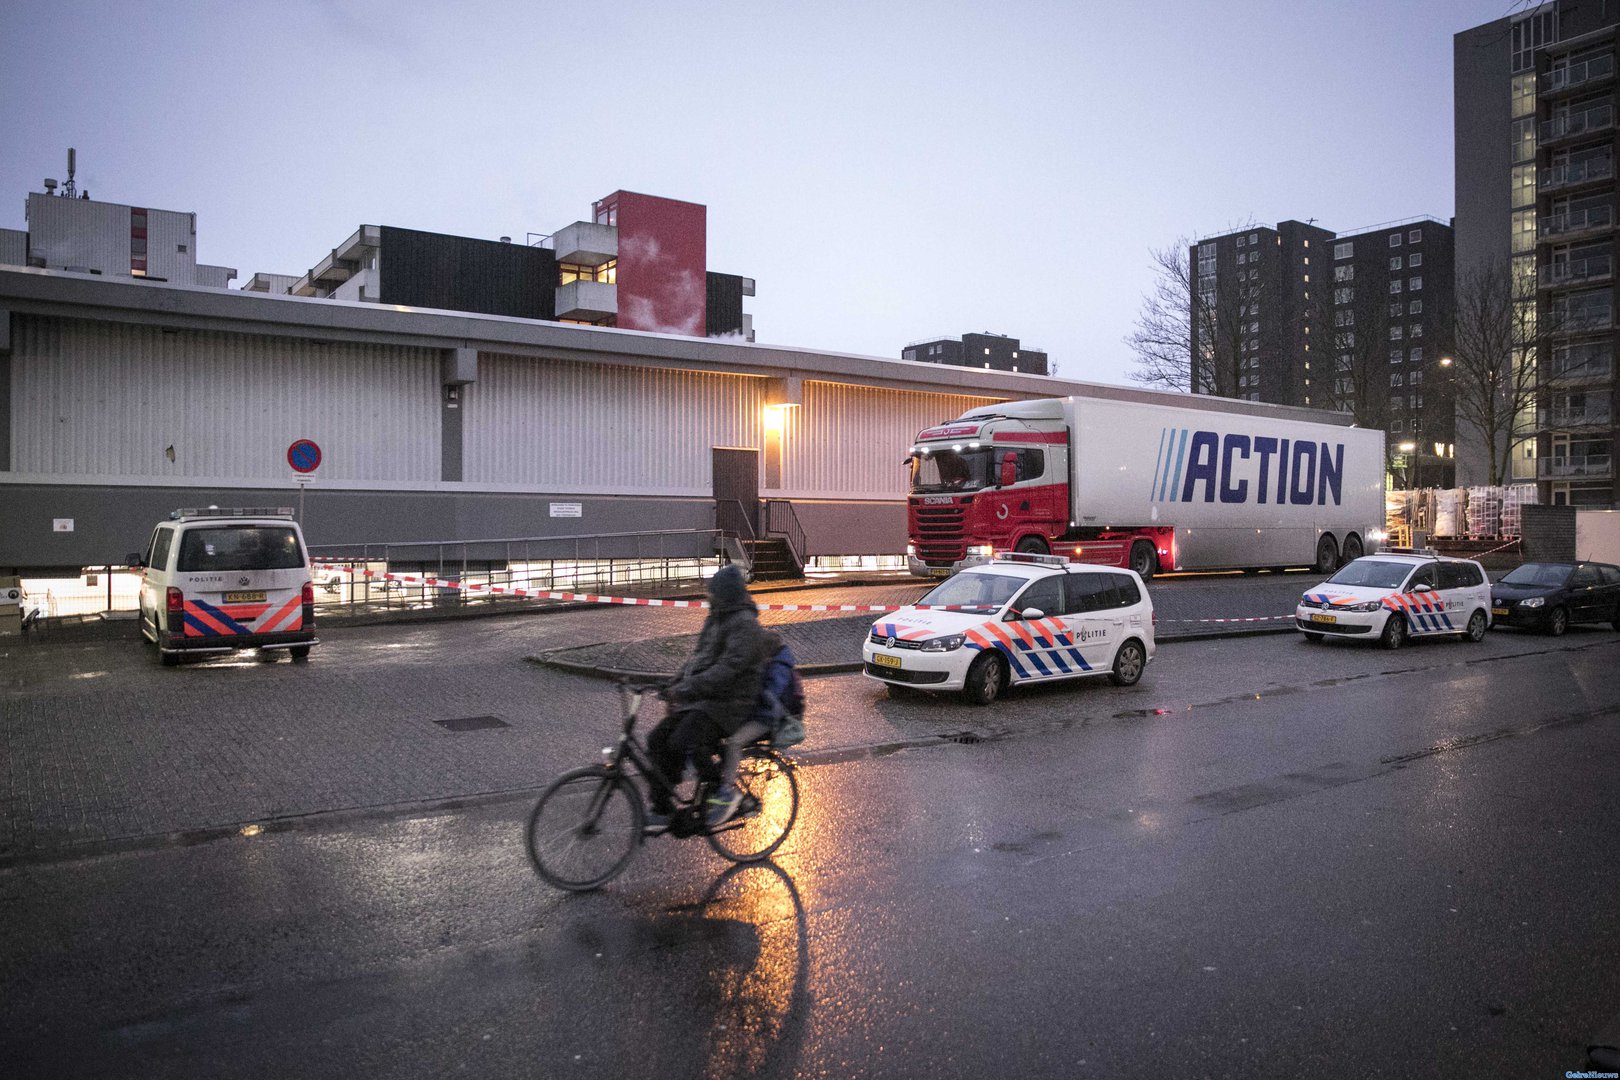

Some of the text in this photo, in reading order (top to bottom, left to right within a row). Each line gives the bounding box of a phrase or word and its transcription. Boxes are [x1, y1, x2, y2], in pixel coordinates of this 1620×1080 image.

[1181, 431, 1345, 506] ACTION
[924, 496, 953, 505] SCANIA
[1076, 628, 1107, 641] POLITIE
